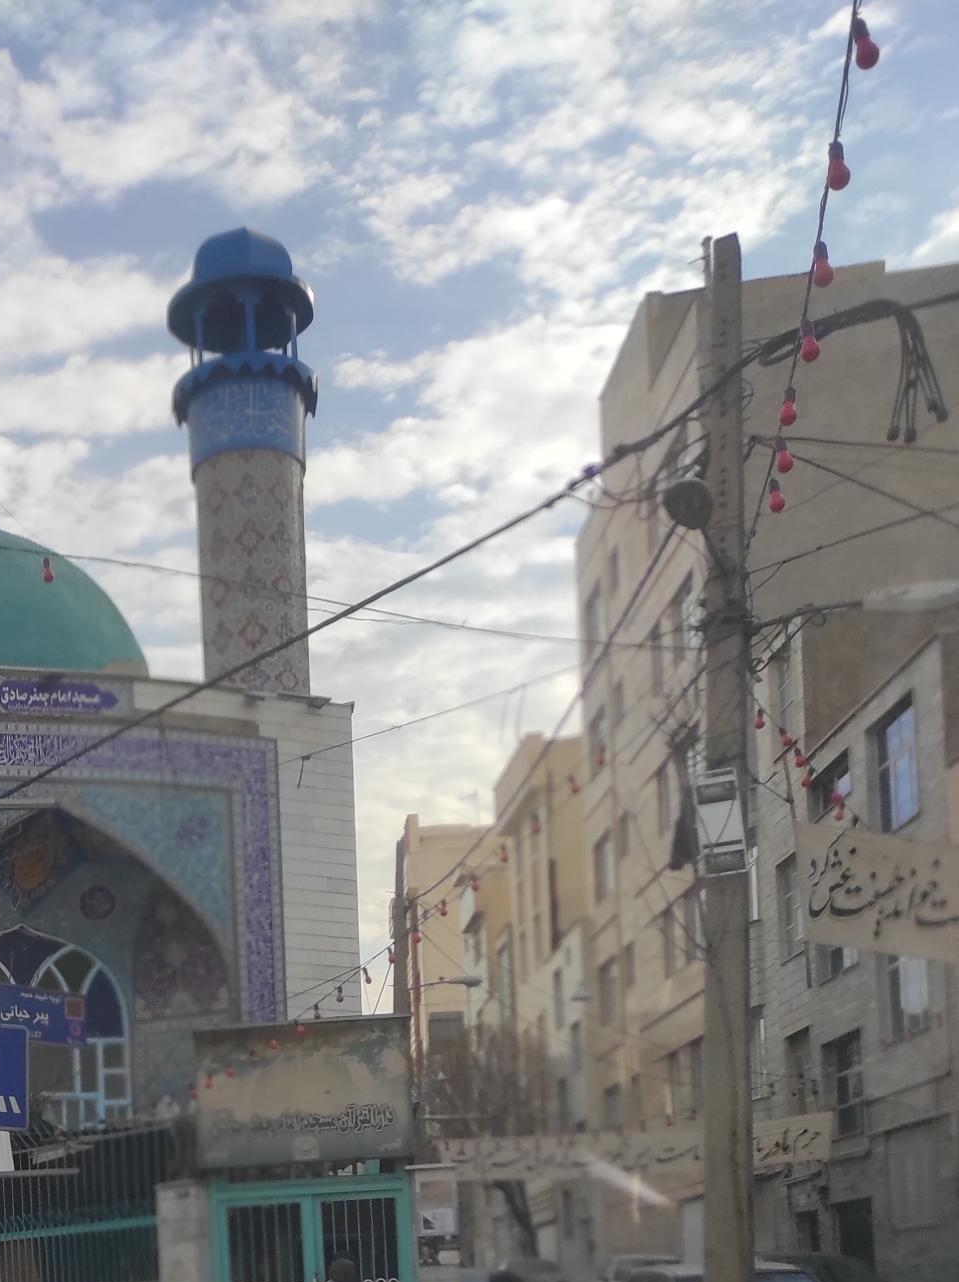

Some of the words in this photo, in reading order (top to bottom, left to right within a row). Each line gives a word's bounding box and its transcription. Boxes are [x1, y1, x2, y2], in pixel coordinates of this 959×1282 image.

[0, 686, 28, 704] صادق
[28, 687, 50, 706] جعفر
[50, 689, 72, 705] امام
[73, 690, 100, 709] مسجد
